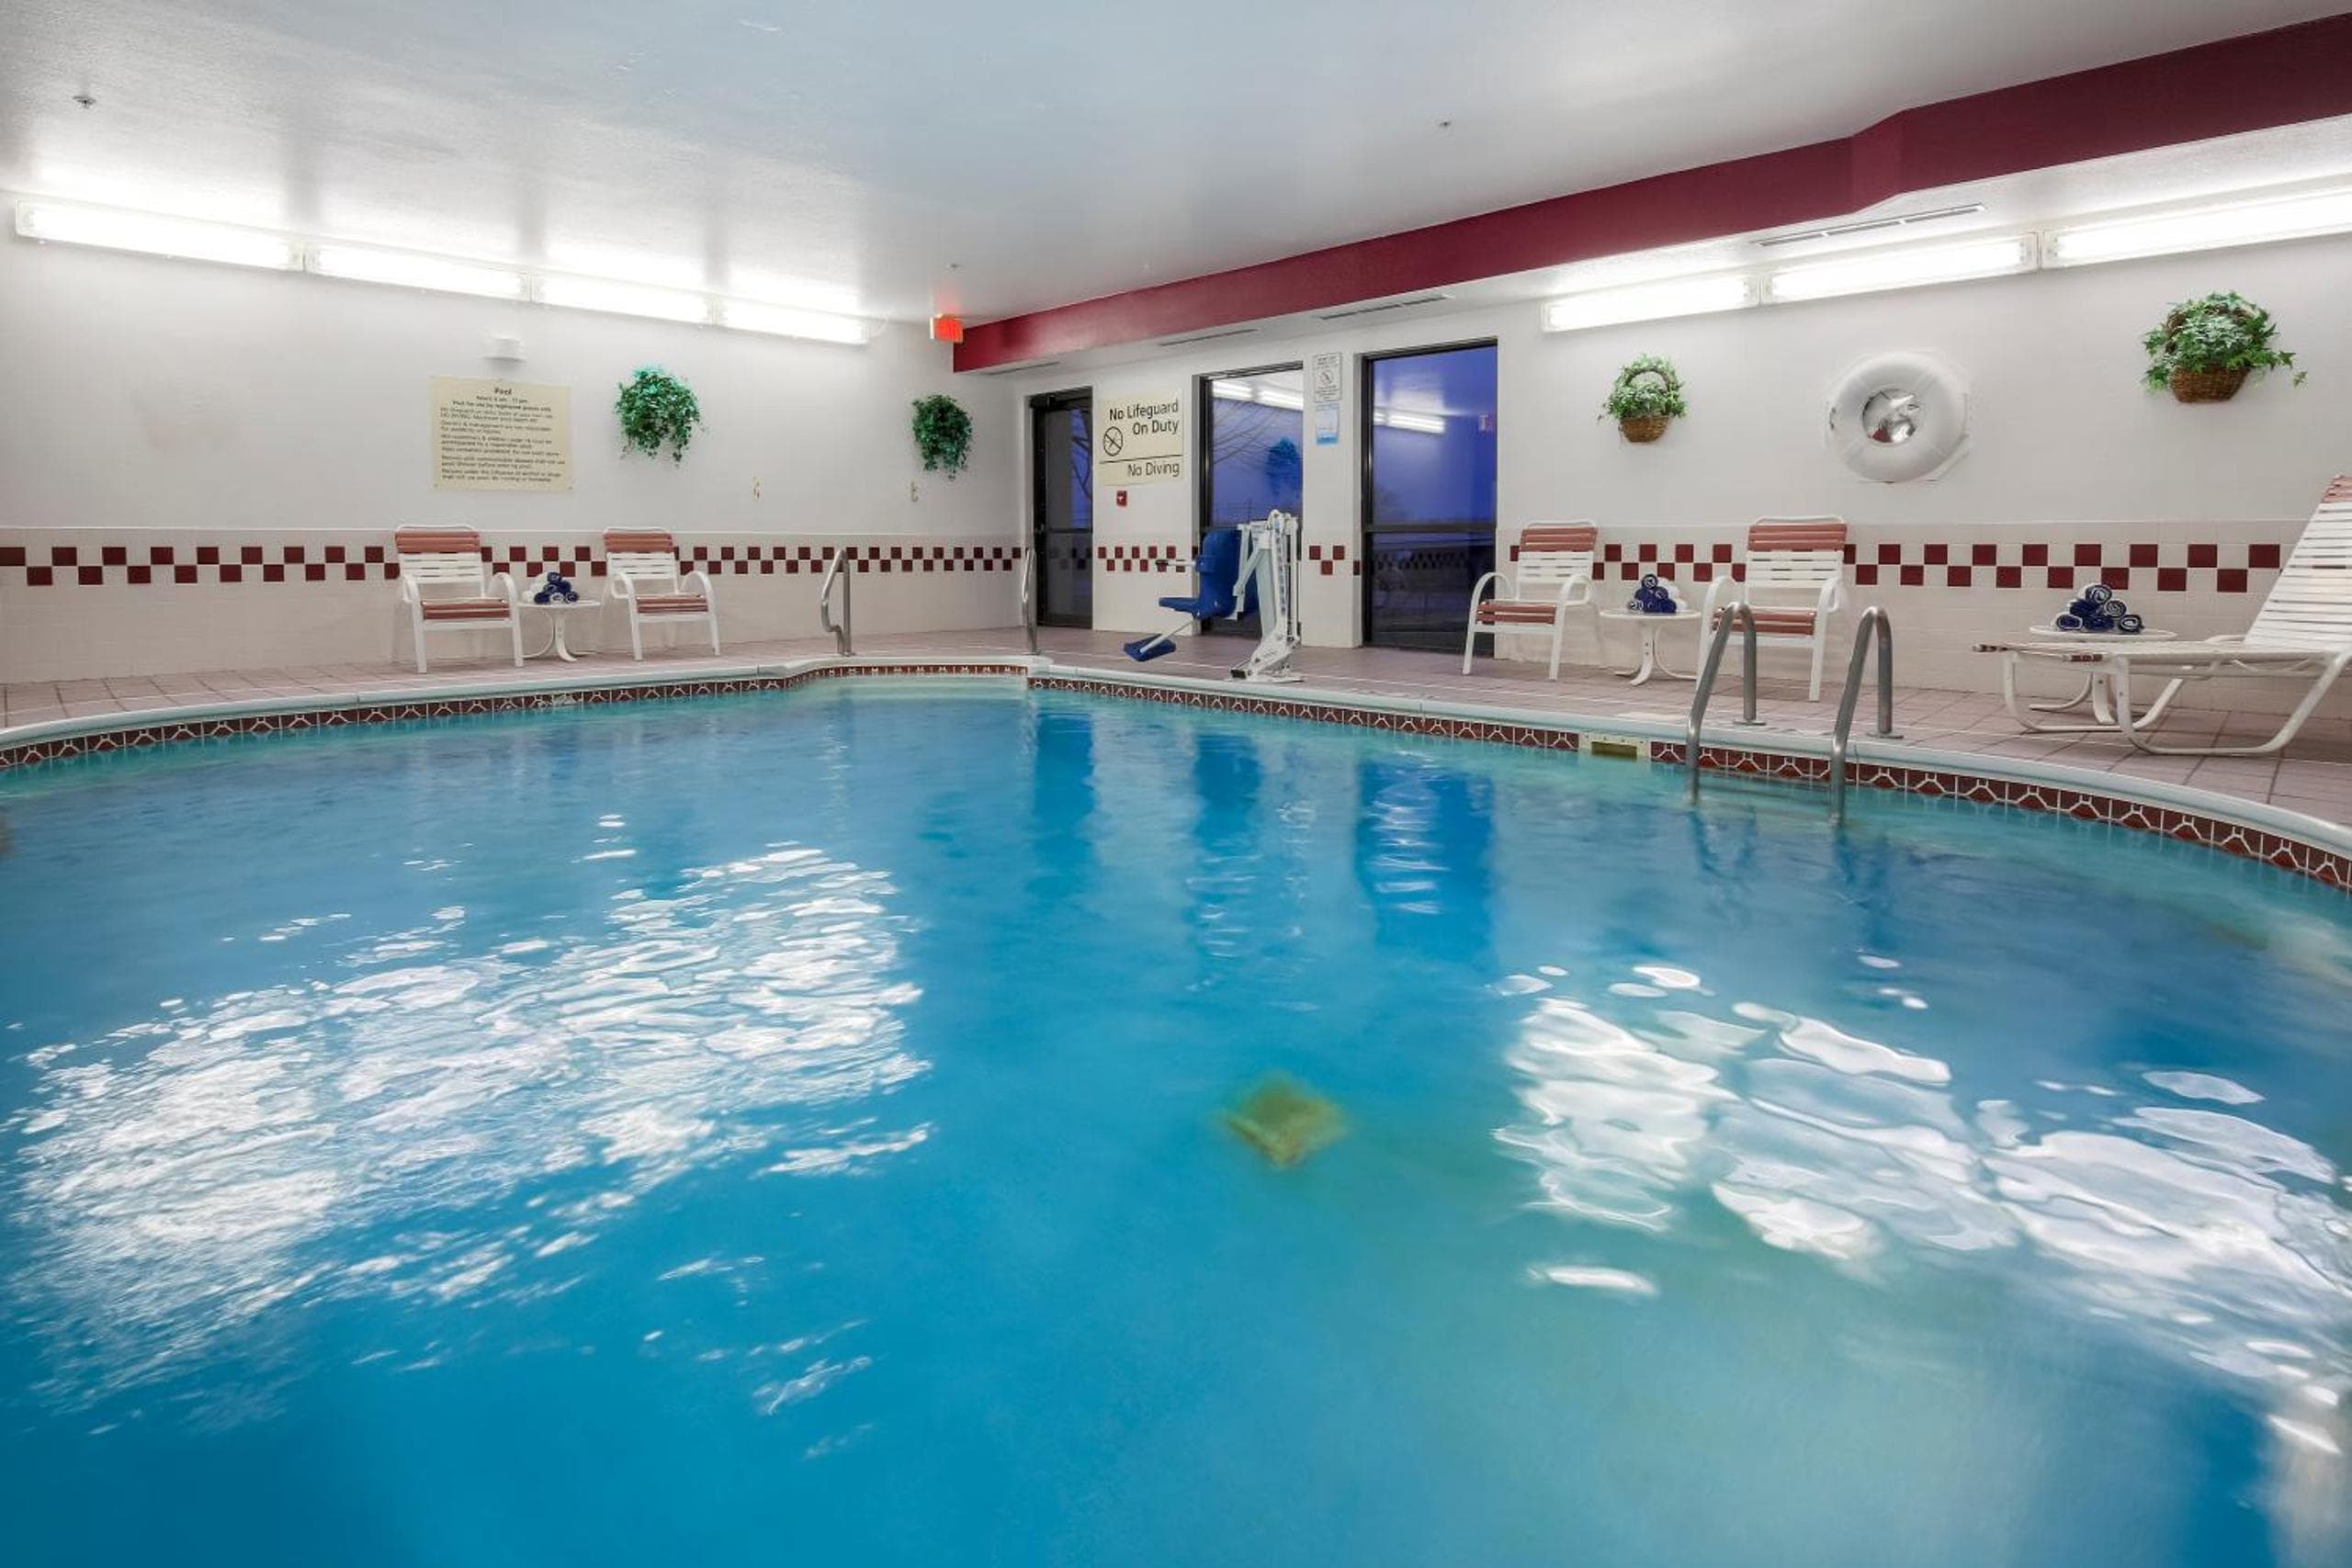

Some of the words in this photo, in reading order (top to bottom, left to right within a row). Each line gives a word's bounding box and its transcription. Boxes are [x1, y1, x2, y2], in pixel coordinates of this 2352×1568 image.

[494, 387, 512, 395] Pool
[1109, 407, 1125, 421] No
[1126, 399, 1179, 420] Lifeguard
[1132, 422, 1148, 435] On
[1151, 420, 1180, 435] Duty
[1128, 463, 1142, 477] No
[1146, 460, 1181, 478] Diving
